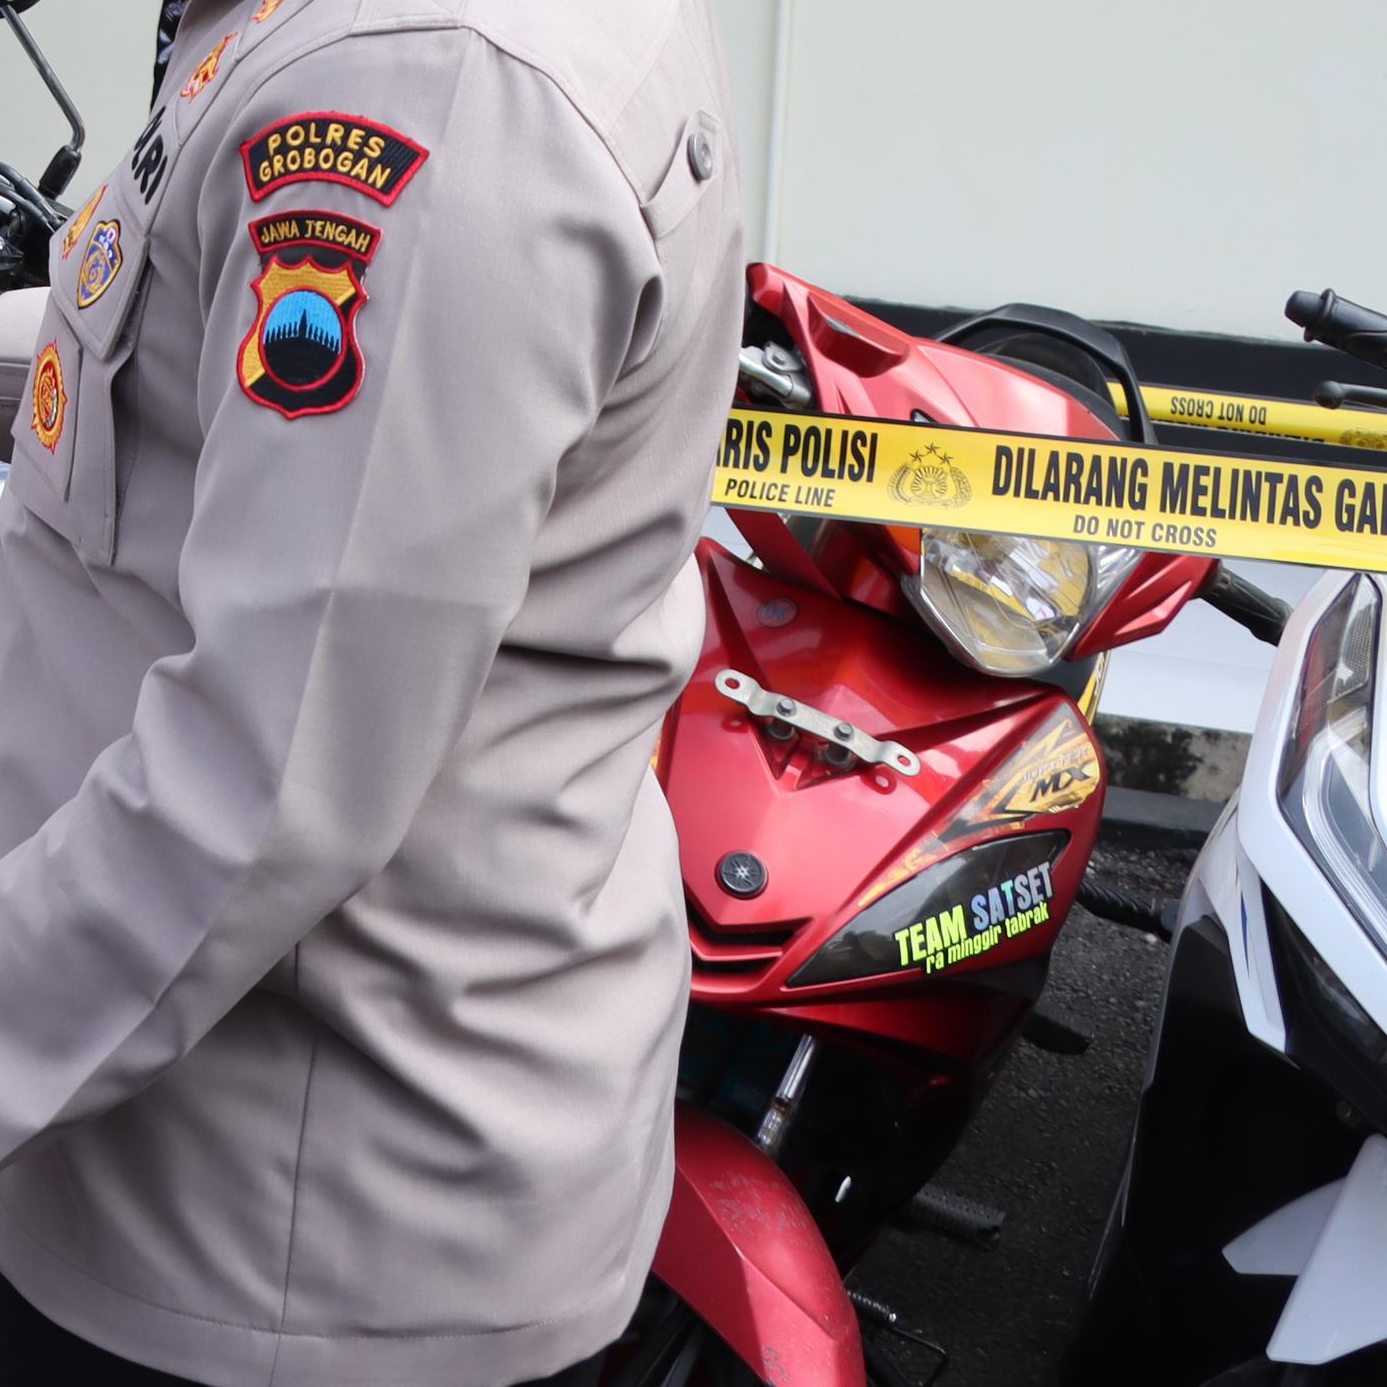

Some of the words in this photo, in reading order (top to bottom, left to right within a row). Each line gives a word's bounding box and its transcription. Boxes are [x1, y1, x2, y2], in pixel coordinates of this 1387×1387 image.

[267, 121, 386, 158] POLRES
[259, 147, 392, 189] GROBOGAN
[260, 219, 300, 244] JAWA
[304, 219, 371, 253] TENGAH
[1170, 396, 1214, 419] CROSS
[1219, 401, 1244, 423] NOT
[1248, 404, 1268, 426] DO
[724, 477, 790, 502] POLICE
[794, 485, 836, 508] LINE
[780, 423, 878, 484] POLISI
[991, 444, 1149, 511] DILARANG
[1158, 460, 1324, 530] MELINTAS
[1073, 513, 1100, 536] DO
[1105, 516, 1146, 540] NOT
[1150, 521, 1218, 548] CROSS
[1029, 761, 1093, 803] MX
[894, 904, 968, 967] TEAM
[970, 861, 1054, 931] SATSET
[926, 952, 945, 975] ra
[947, 923, 1002, 964] minggir
[1005, 902, 1050, 938] tabrak
